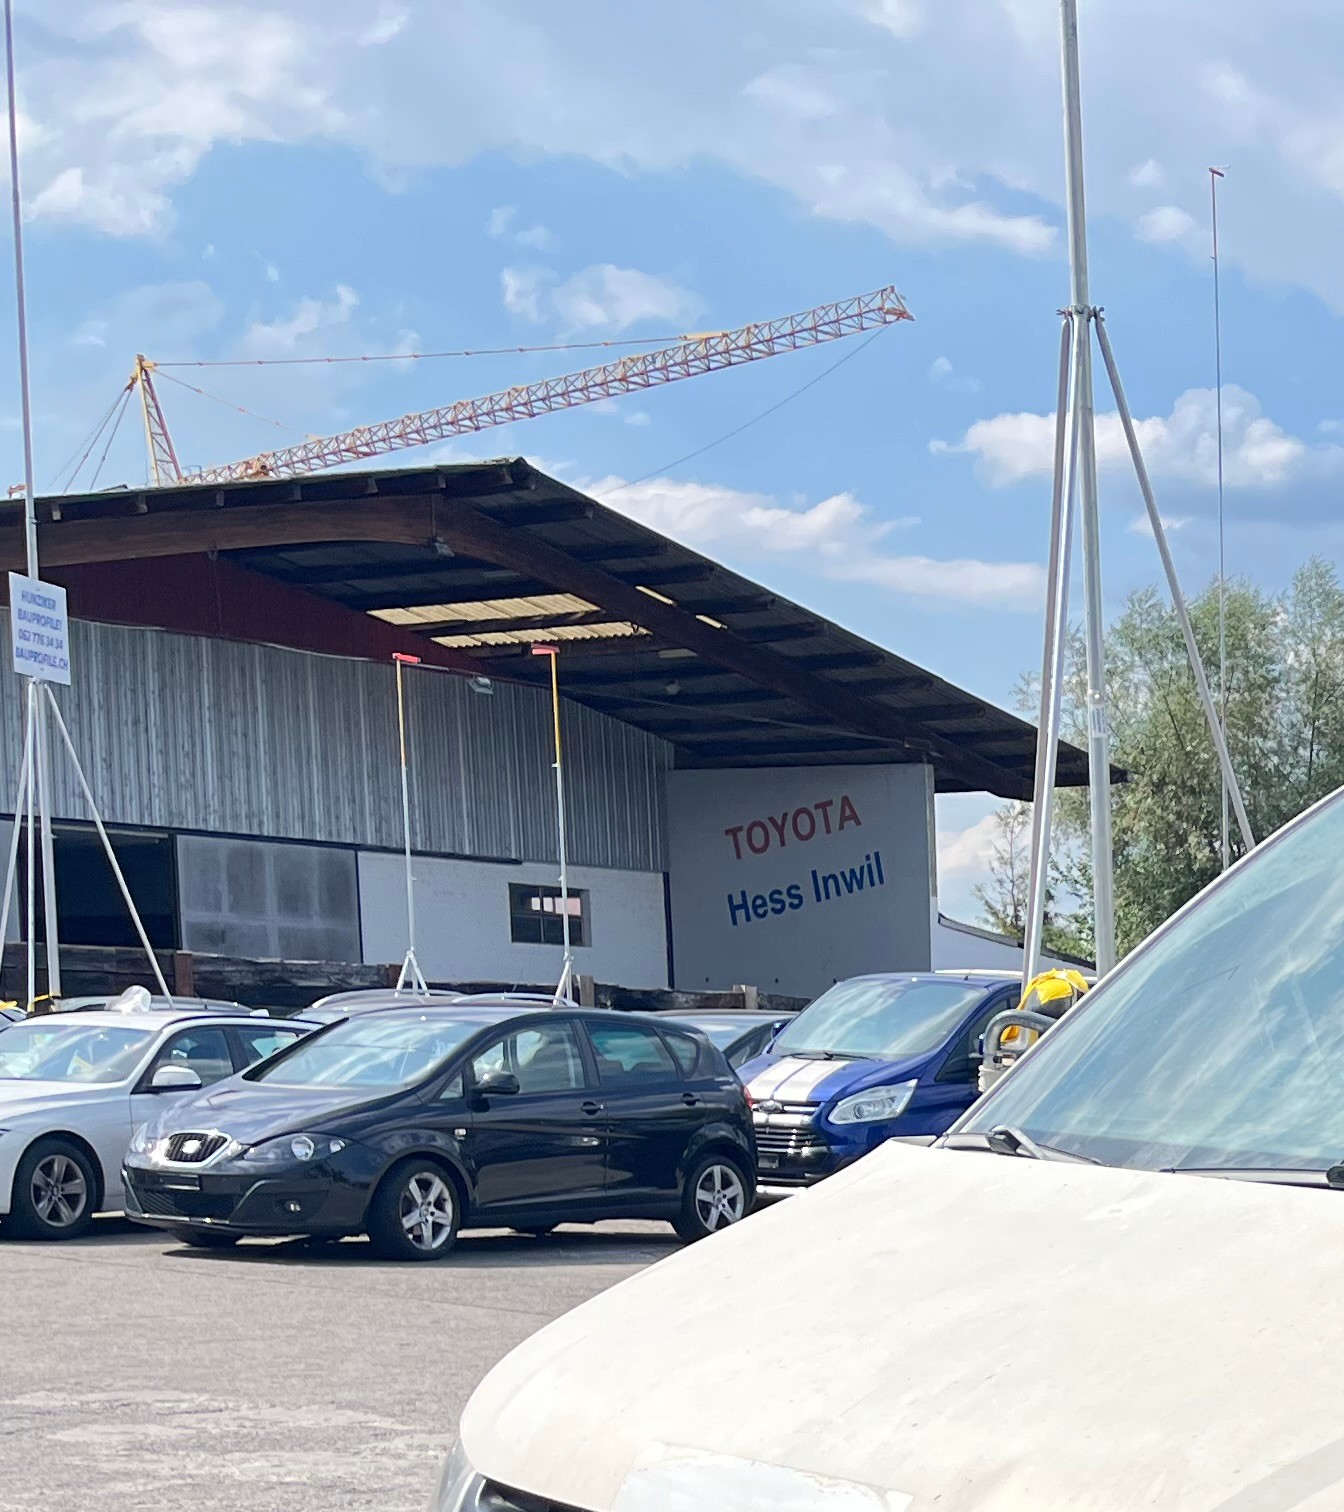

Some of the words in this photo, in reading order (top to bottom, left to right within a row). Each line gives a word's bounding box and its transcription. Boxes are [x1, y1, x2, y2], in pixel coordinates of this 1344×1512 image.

[18, 628, 31, 642] 062
[32, 631, 45, 646] 776
[45, 635, 54, 648] 34
[55, 638, 64, 650] 34
[725, 795, 862, 860] TOYOTA
[727, 884, 804, 926] Hess
[811, 851, 885, 903] Inwil
